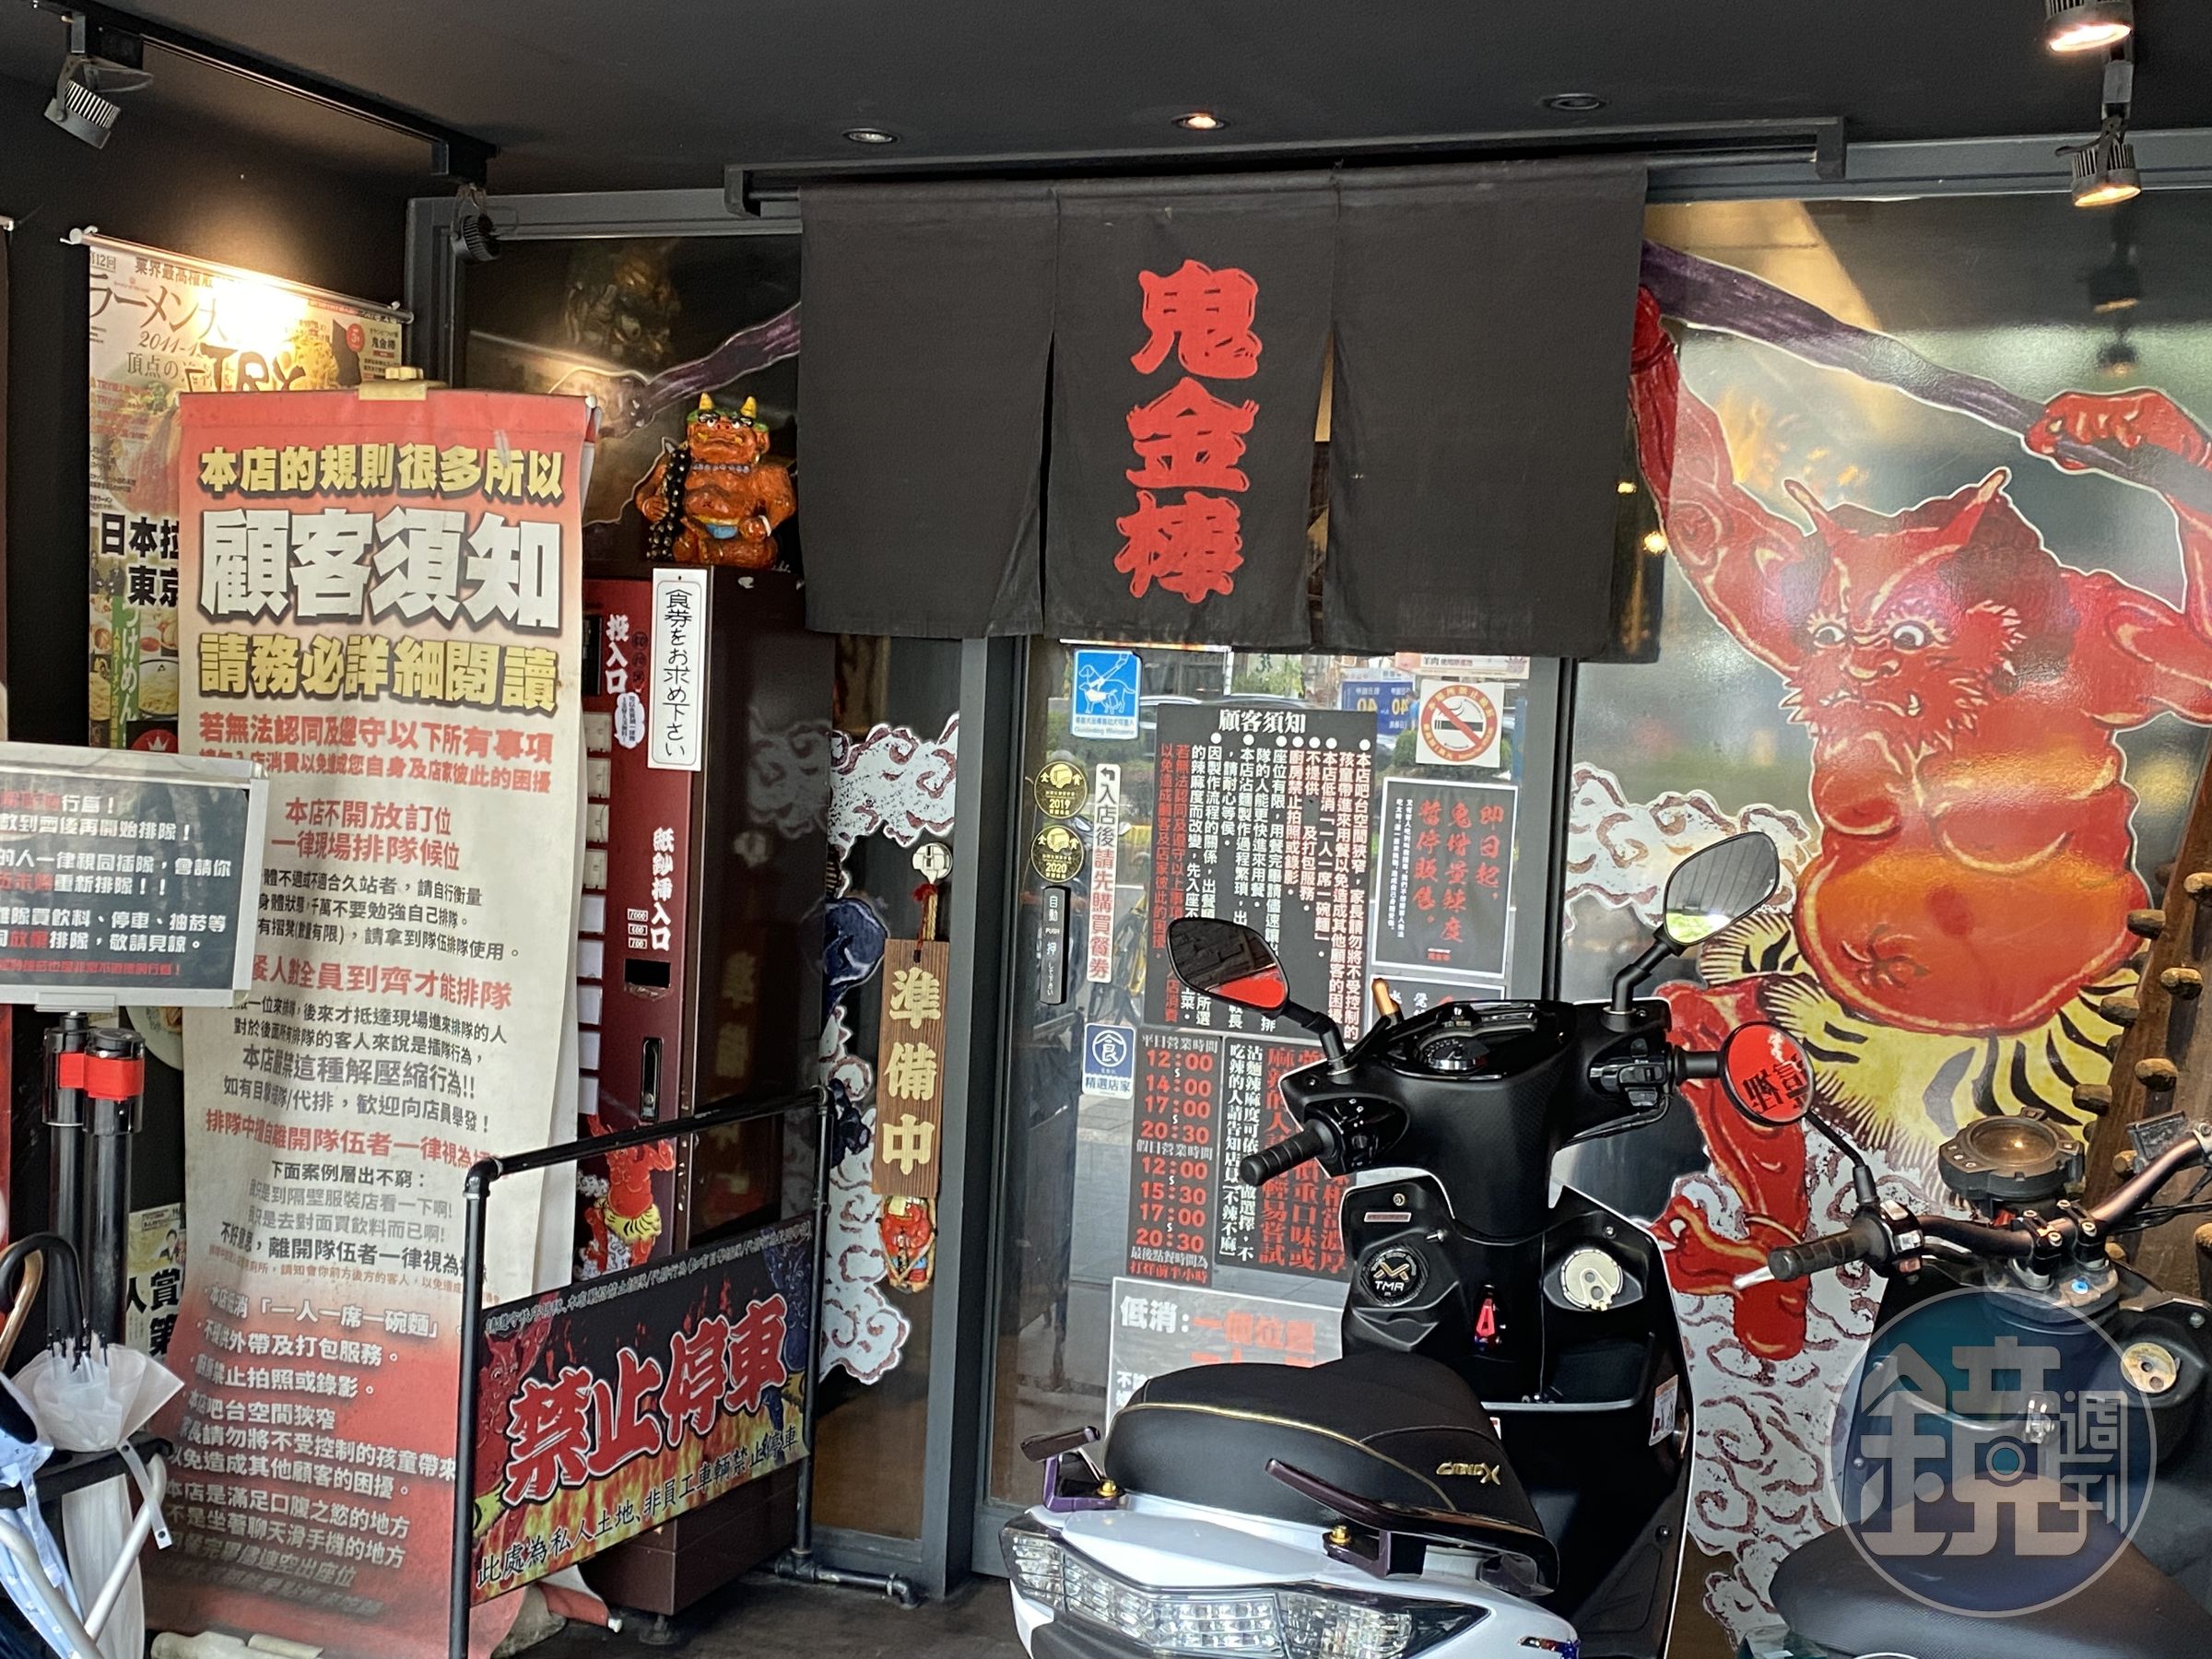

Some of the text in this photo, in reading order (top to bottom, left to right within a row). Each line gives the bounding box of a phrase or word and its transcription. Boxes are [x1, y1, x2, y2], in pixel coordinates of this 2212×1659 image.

[1113, 259, 1263, 604] 鬼金棒
[200, 442, 564, 500] 本店的規則很多所以
[201, 507, 563, 633] 顧客須知
[199, 633, 559, 713] 請務必詳細閱讀
[605, 613, 630, 695] 投入口
[662, 588, 692, 758] 食券をお求め下さい
[199, 712, 554, 765] 若無法認同及遵守以下所有事項
[1218, 708, 1307, 735] 顧客須知
[285, 796, 452, 837] 本店不開放訂位
[1049, 798, 1071, 810] 2019
[270, 831, 461, 872] 一律現場排隊候位
[1089, 781, 1117, 980] 入店後請先購買餐券
[881, 965, 942, 1177] 準備中
[1147, 1049, 1214, 1073] 12:00
[1144, 1095, 1211, 1119] 17:00
[1146, 1075, 1213, 1098] 14:00
[1140, 1120, 1210, 1145] 20:30
[1141, 1156, 1208, 1181] 12:00
[1140, 1181, 1207, 1206] 15:30
[1138, 1203, 1206, 1228] 17:00
[1135, 1227, 1206, 1253] 20:30
[1374, 1280, 1405, 1292] TMR
[501, 1292, 788, 1508] 禁止停車
